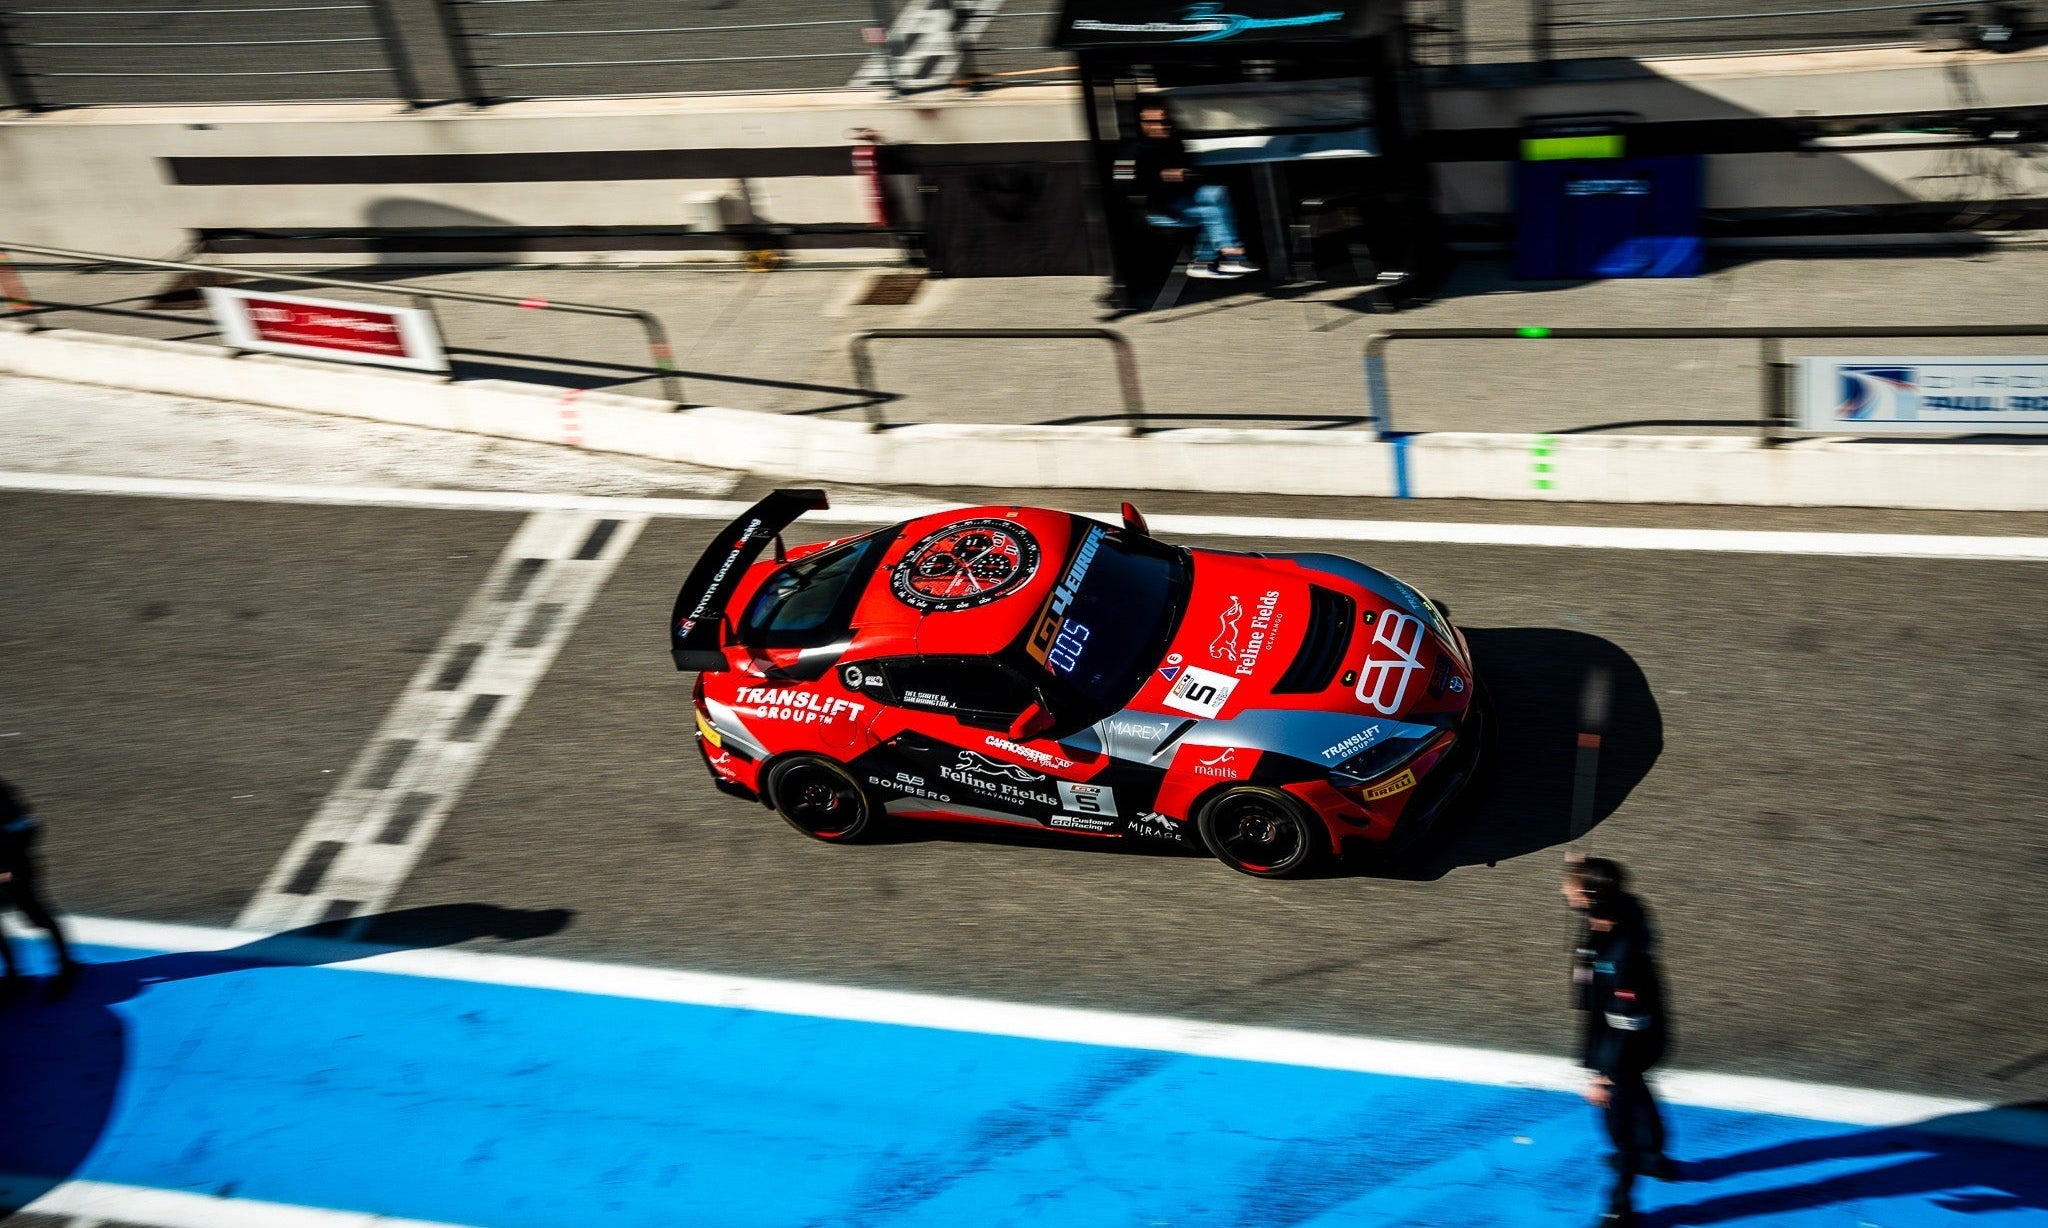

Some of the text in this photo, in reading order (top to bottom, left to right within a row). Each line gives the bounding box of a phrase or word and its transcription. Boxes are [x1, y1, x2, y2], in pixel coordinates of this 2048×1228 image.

[1064, 525, 1107, 594] EUROPE
[689, 583, 719, 619] TOYOTA
[1048, 618, 1091, 673] 005
[1235, 590, 1280, 675] Feline Fields
[1185, 682, 1217, 705] 5
[1108, 720, 1162, 741] MAREX
[985, 735, 1054, 761] CARROSSERIE
[1194, 765, 1237, 779] mantis
[868, 775, 951, 802] BOMBERG
[940, 765, 1058, 806] Feline Fields
[973, 788, 1025, 806] OKAVANGO
[1366, 773, 1412, 799] PIRELLI
[1075, 795, 1101, 812] 5
[1071, 822, 1103, 832] Racing
[1072, 817, 1114, 826] Customer
